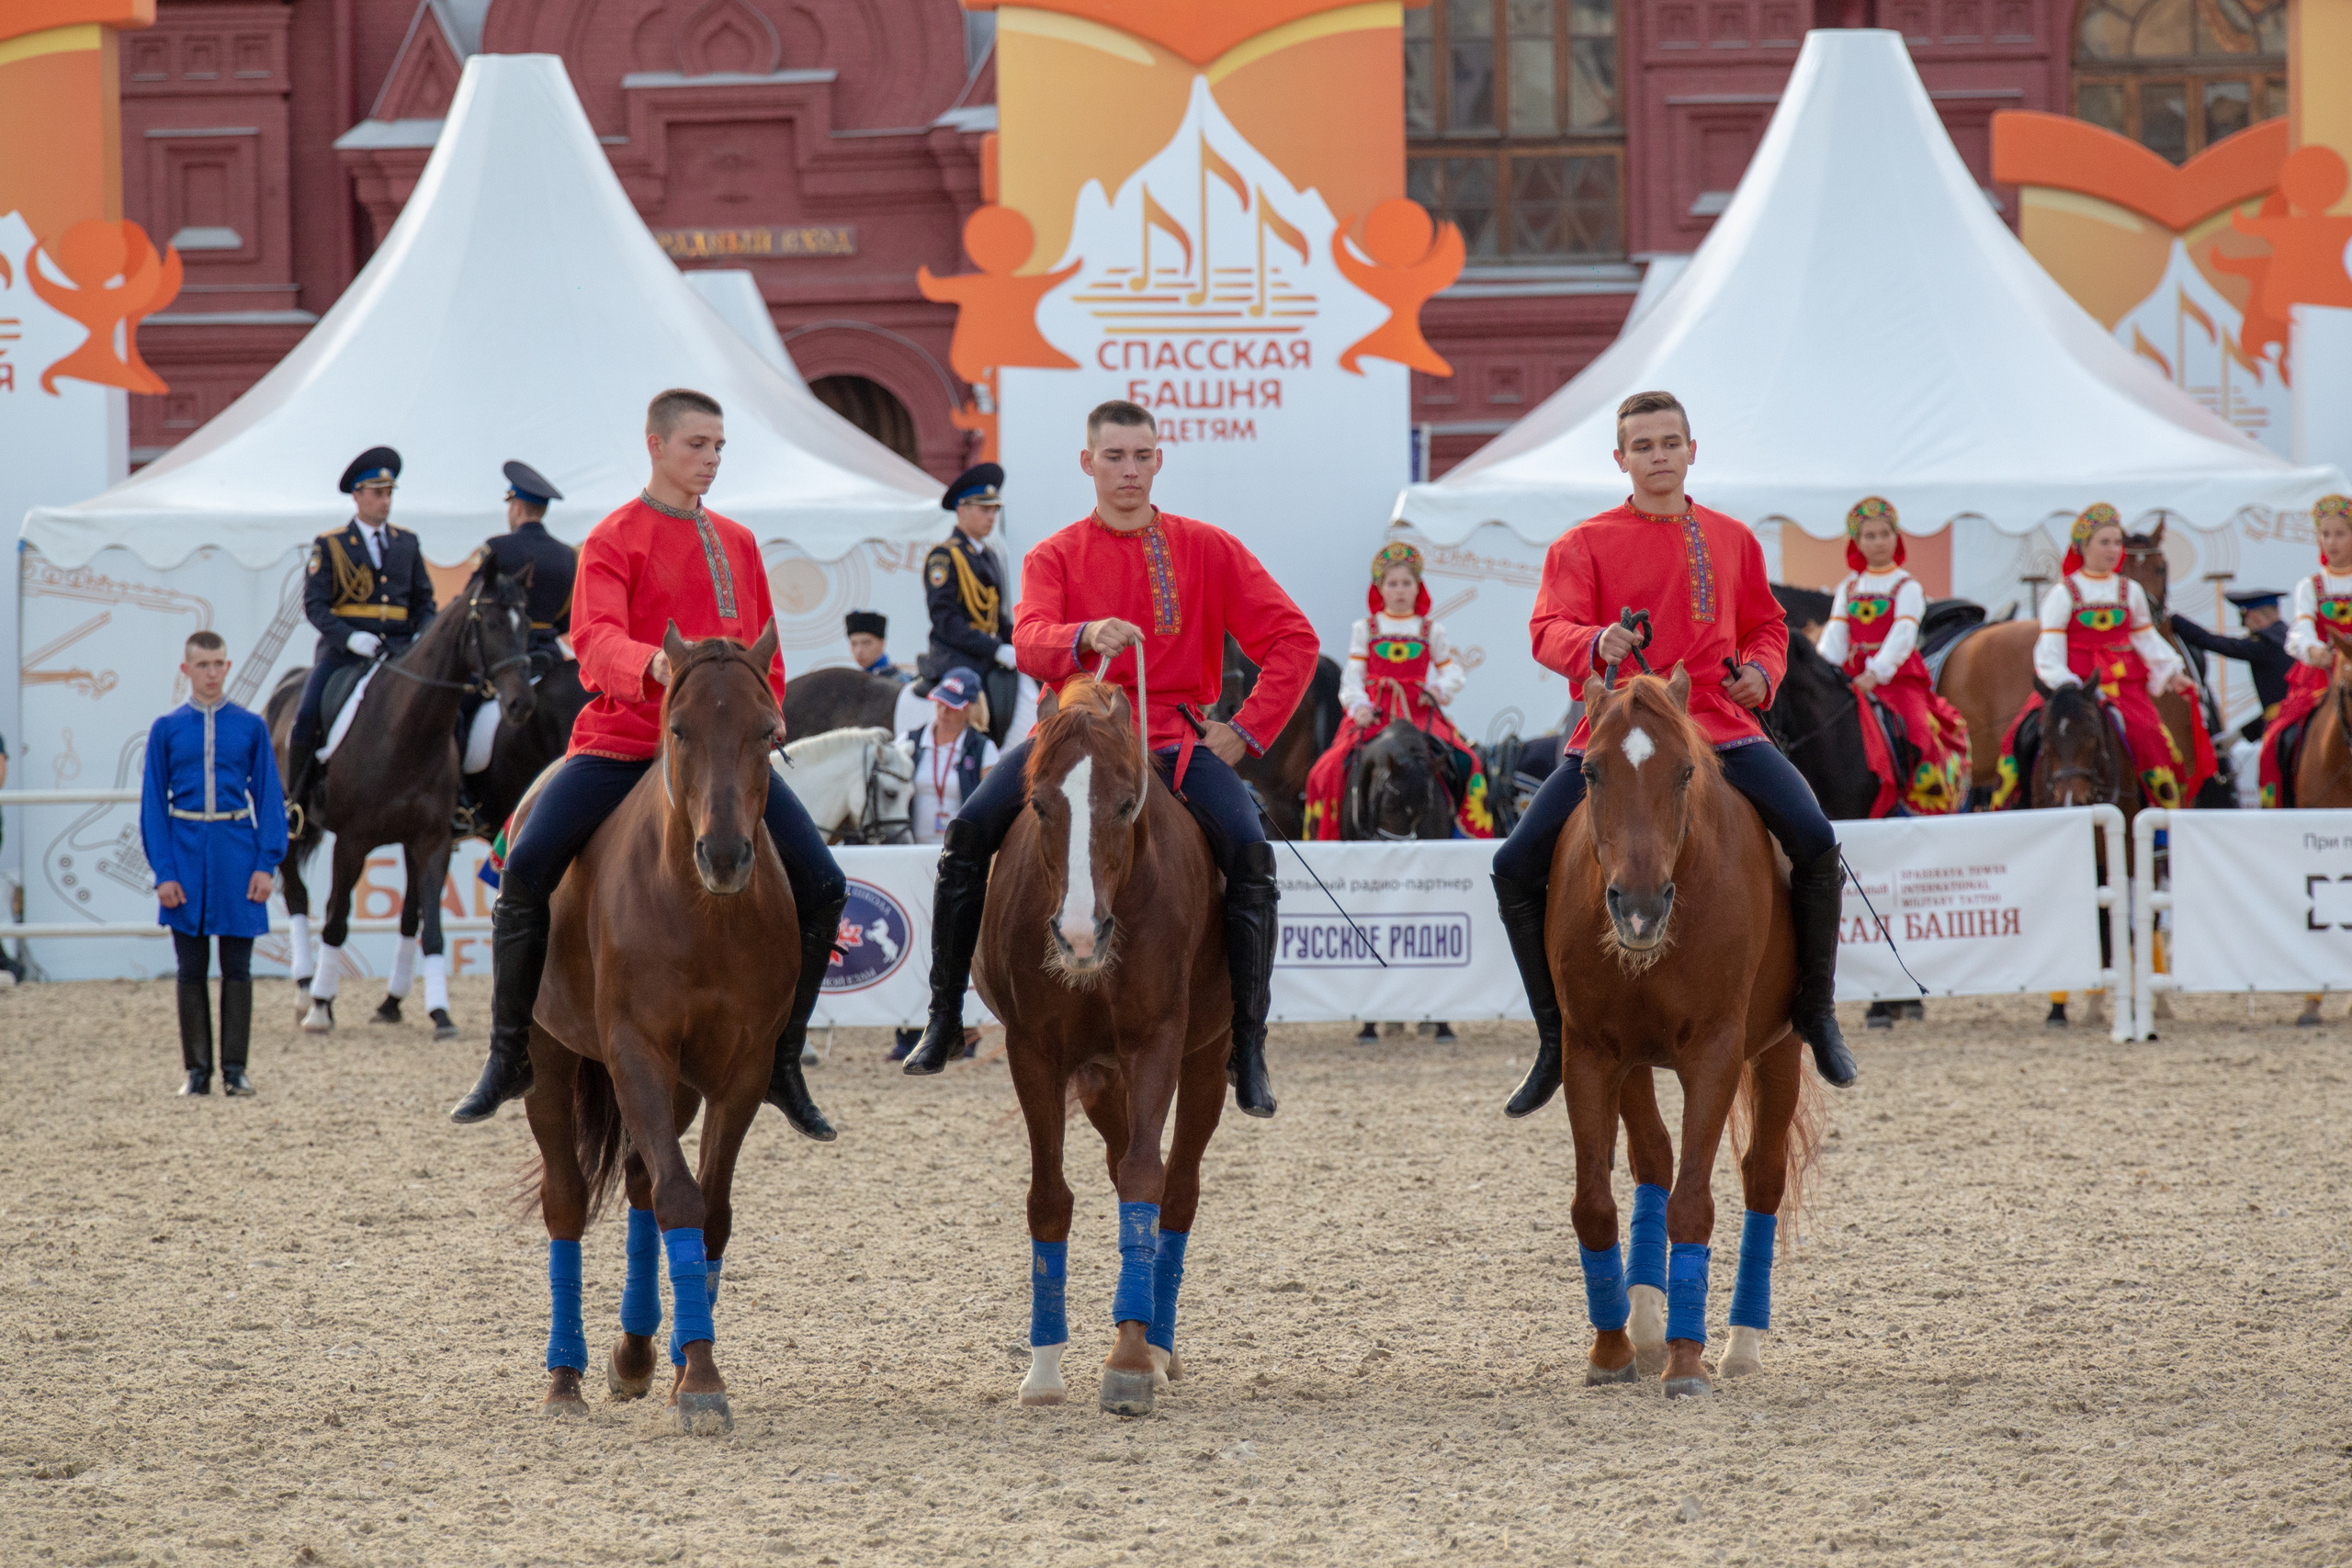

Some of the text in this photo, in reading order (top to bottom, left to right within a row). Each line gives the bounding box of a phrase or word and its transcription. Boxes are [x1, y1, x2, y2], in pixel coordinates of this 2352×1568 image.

[1097, 339, 1311, 370] СПАССКАЯ
[1127, 378, 1282, 409] БАШНЯ
[1157, 418, 1257, 443] ДЕТЯМ
[2303, 832, 2339, 852] При
[1904, 908, 2021, 942] БАШНЯ
[1283, 926, 1381, 959] РУССКОЕ
